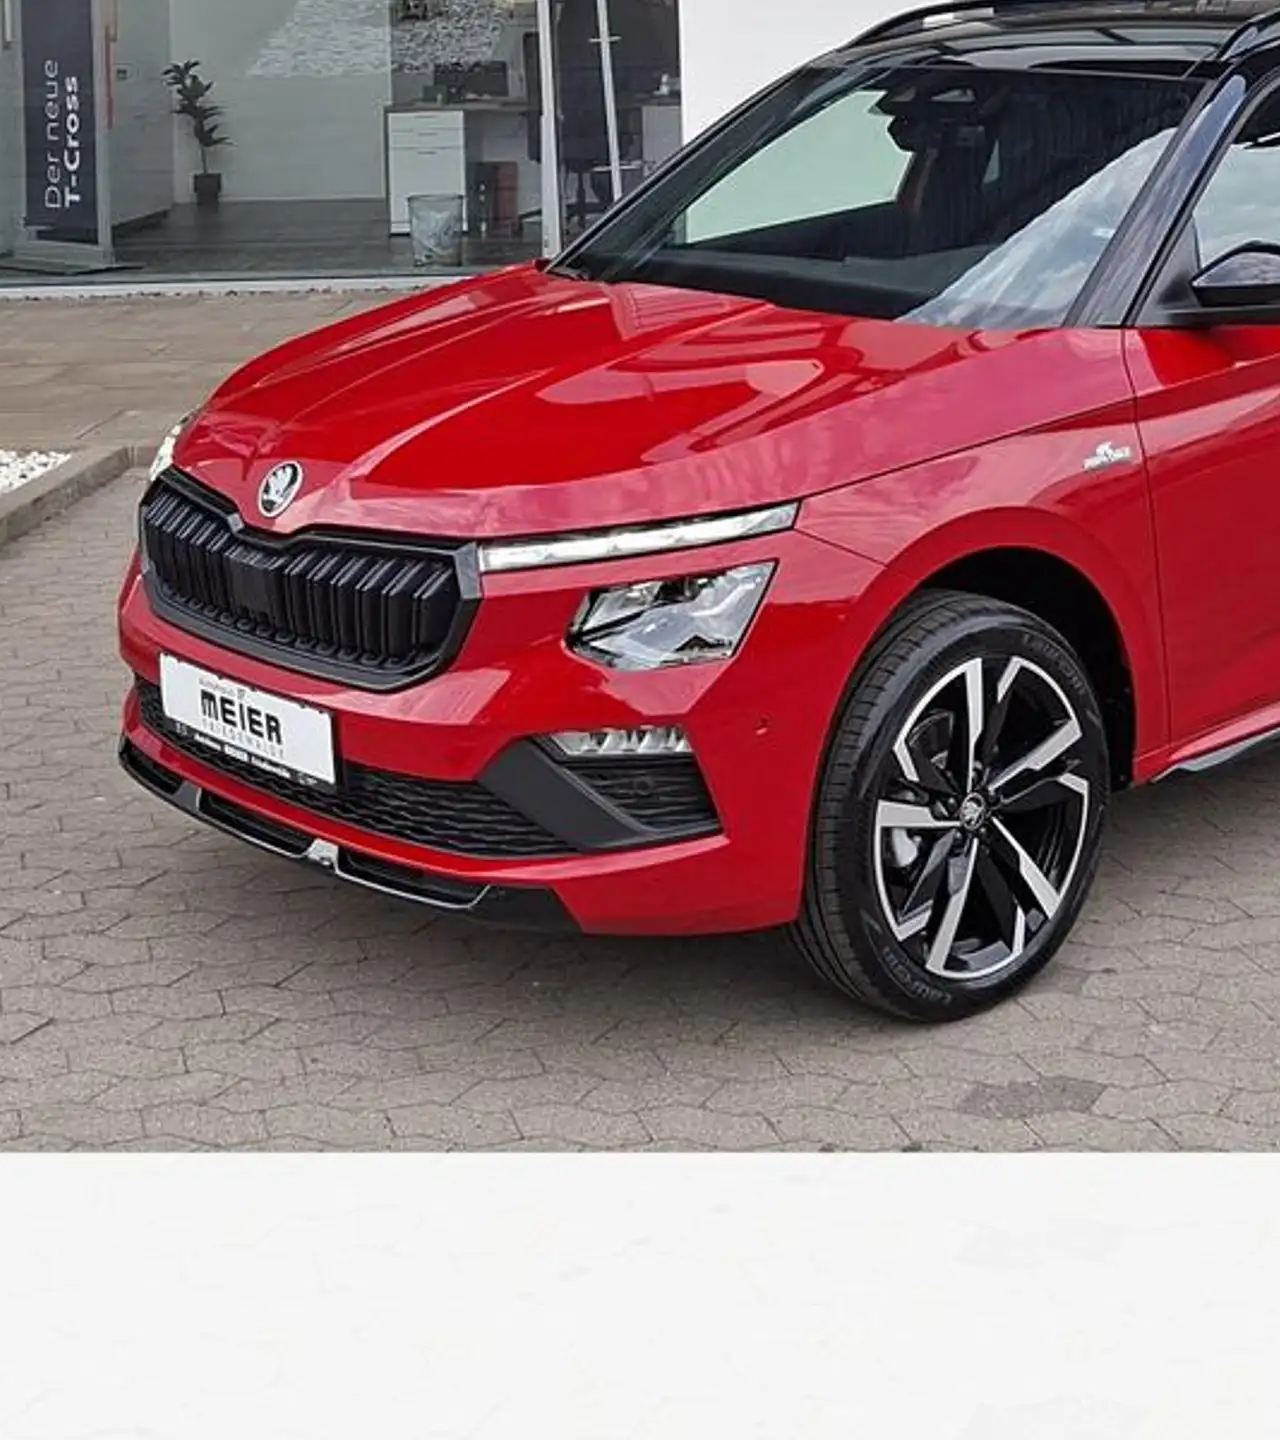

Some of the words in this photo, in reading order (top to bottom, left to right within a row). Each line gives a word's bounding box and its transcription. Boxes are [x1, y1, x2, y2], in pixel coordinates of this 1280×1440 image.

[44, 59, 60, 140] neue
[64, 75, 81, 209] T-Cross
[44, 154, 62, 209] Der
[200, 688, 283, 746] MEIER
